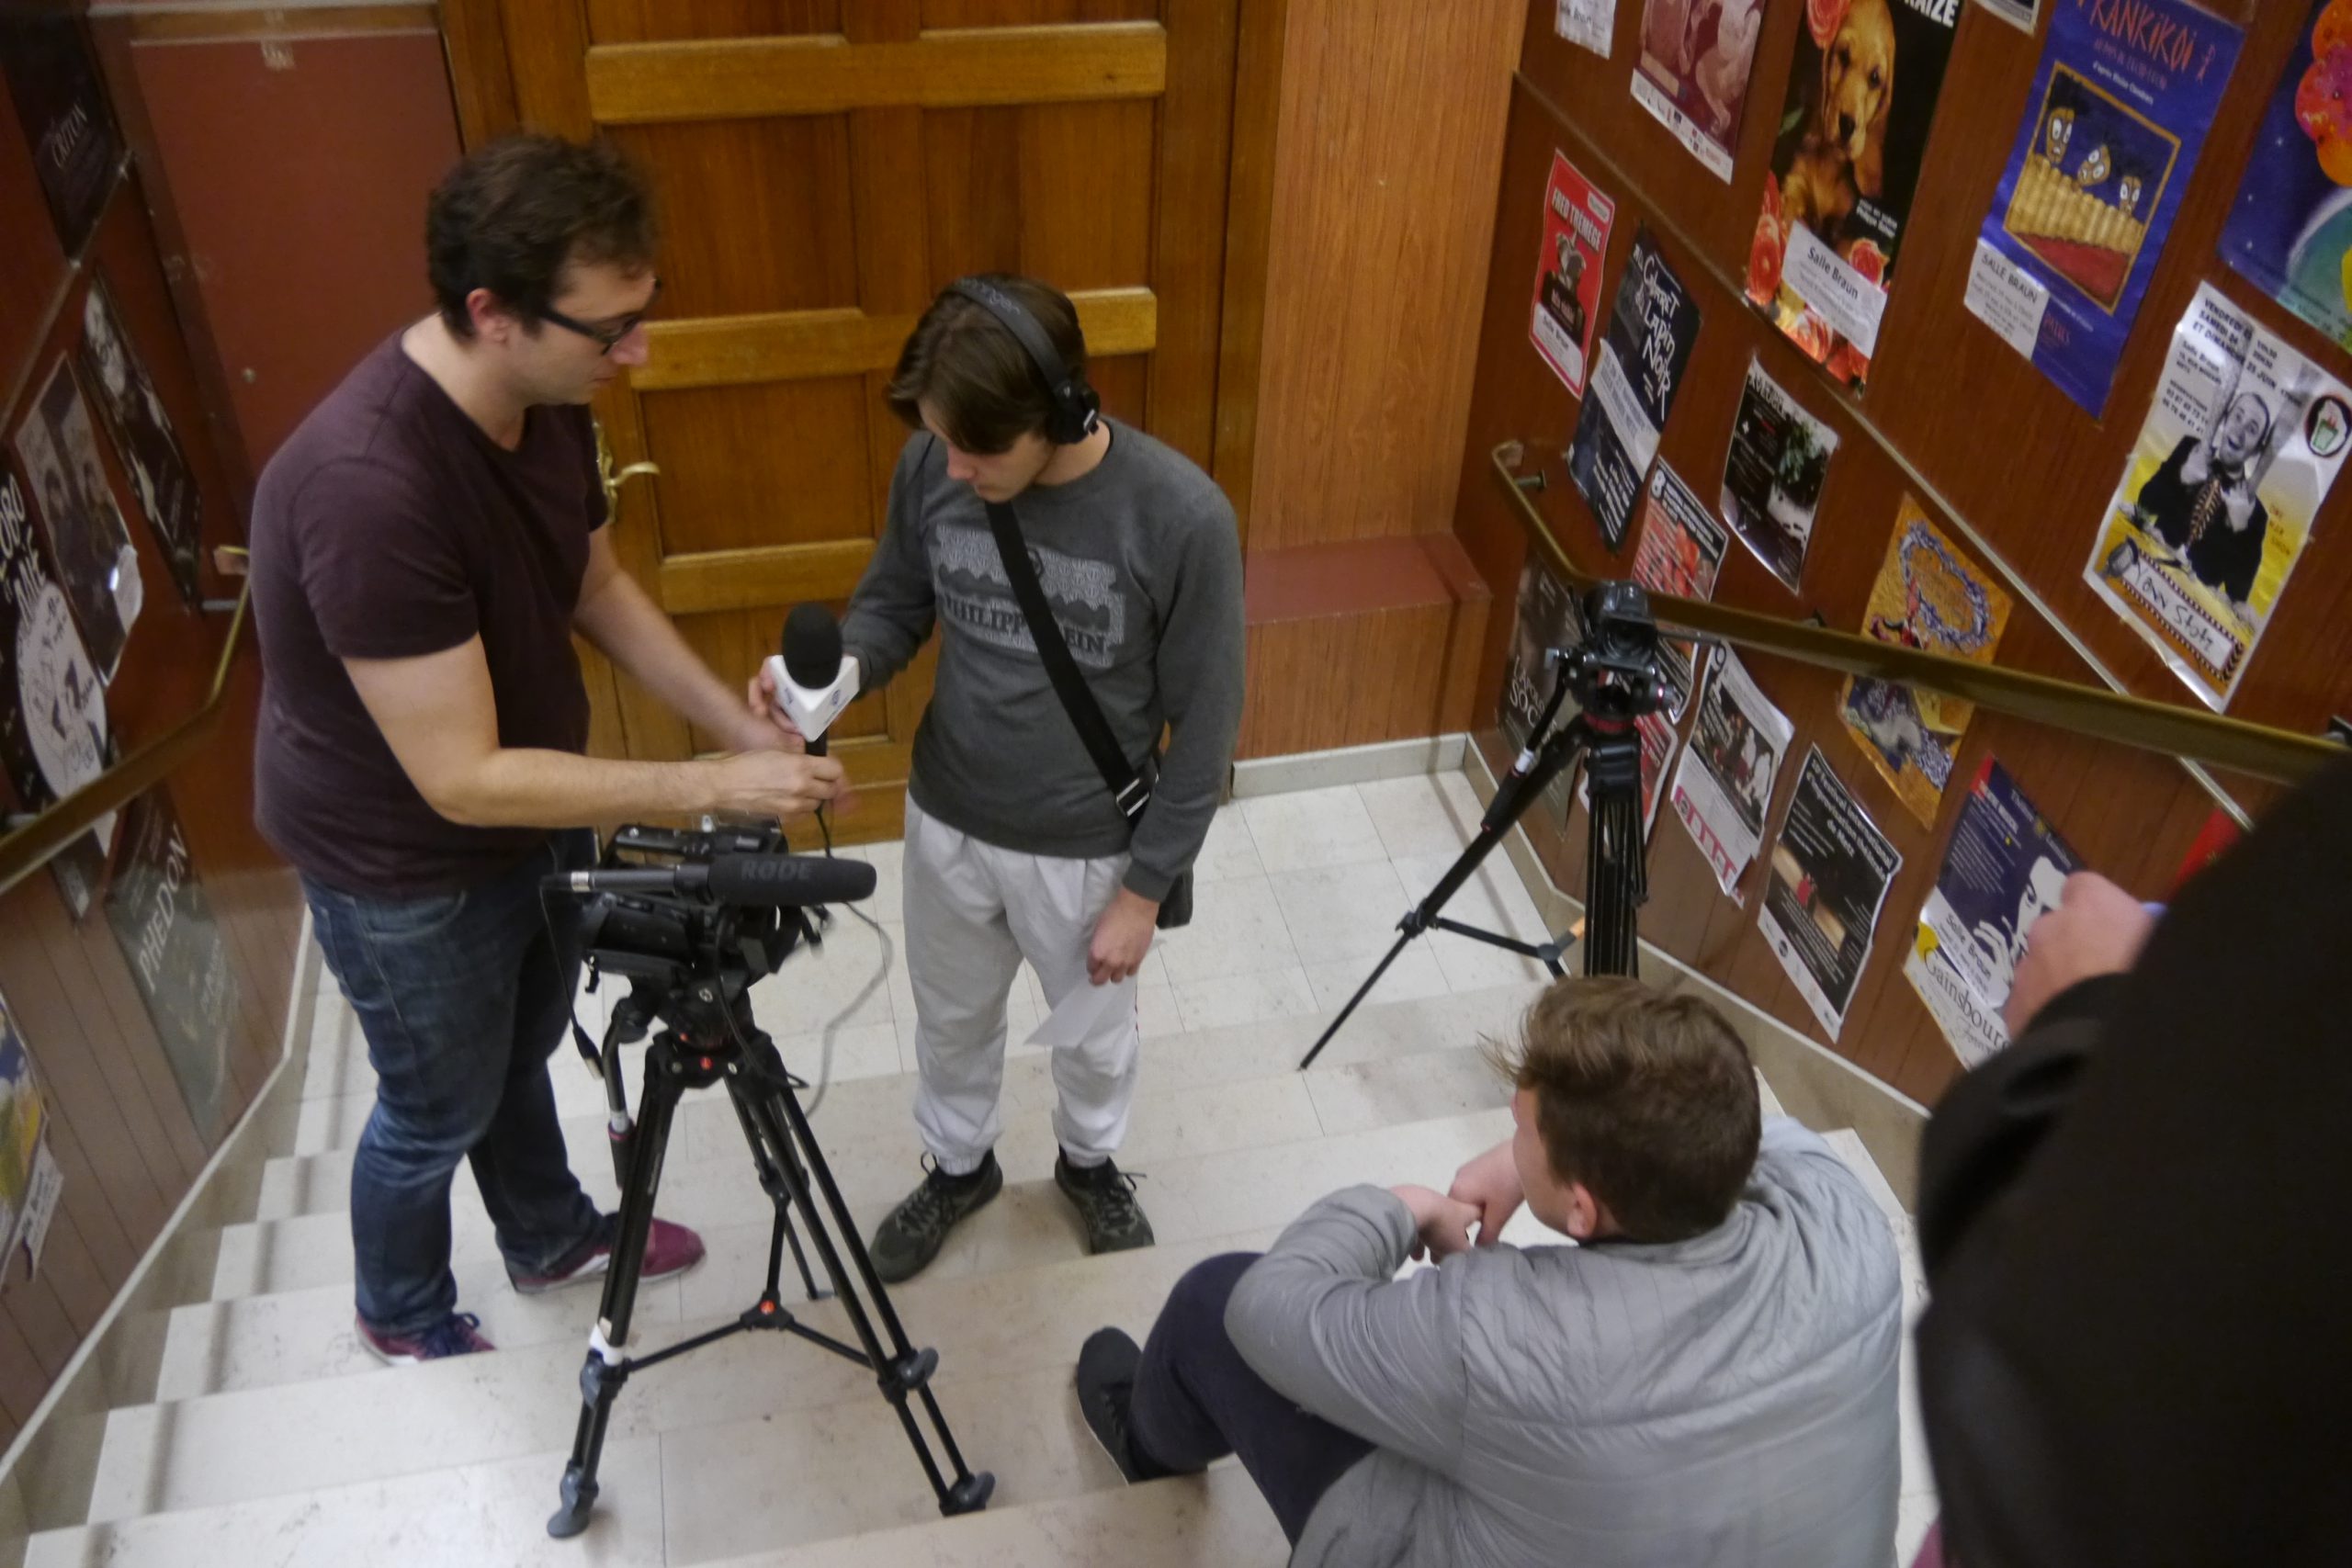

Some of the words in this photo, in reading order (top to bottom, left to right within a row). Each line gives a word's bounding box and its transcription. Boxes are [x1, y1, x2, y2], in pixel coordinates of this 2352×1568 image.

[1551, 184, 1570, 221] FRED
[1807, 243, 1831, 276] Salle
[1831, 265, 1859, 301] Braun
[1981, 251, 2007, 280] SALLE
[2007, 272, 2038, 304] BRAUN
[2200, 310, 2228, 336] SAMEDI
[2205, 299, 2243, 333] VENDREDI
[2256, 369, 2277, 389] JUIN
[1826, 816, 1838, 835] de
[1836, 828, 1856, 858] Metz
[139, 824, 189, 997] PHEDON
[1945, 913, 1967, 942] Salle
[1967, 941, 1994, 981] Braun
